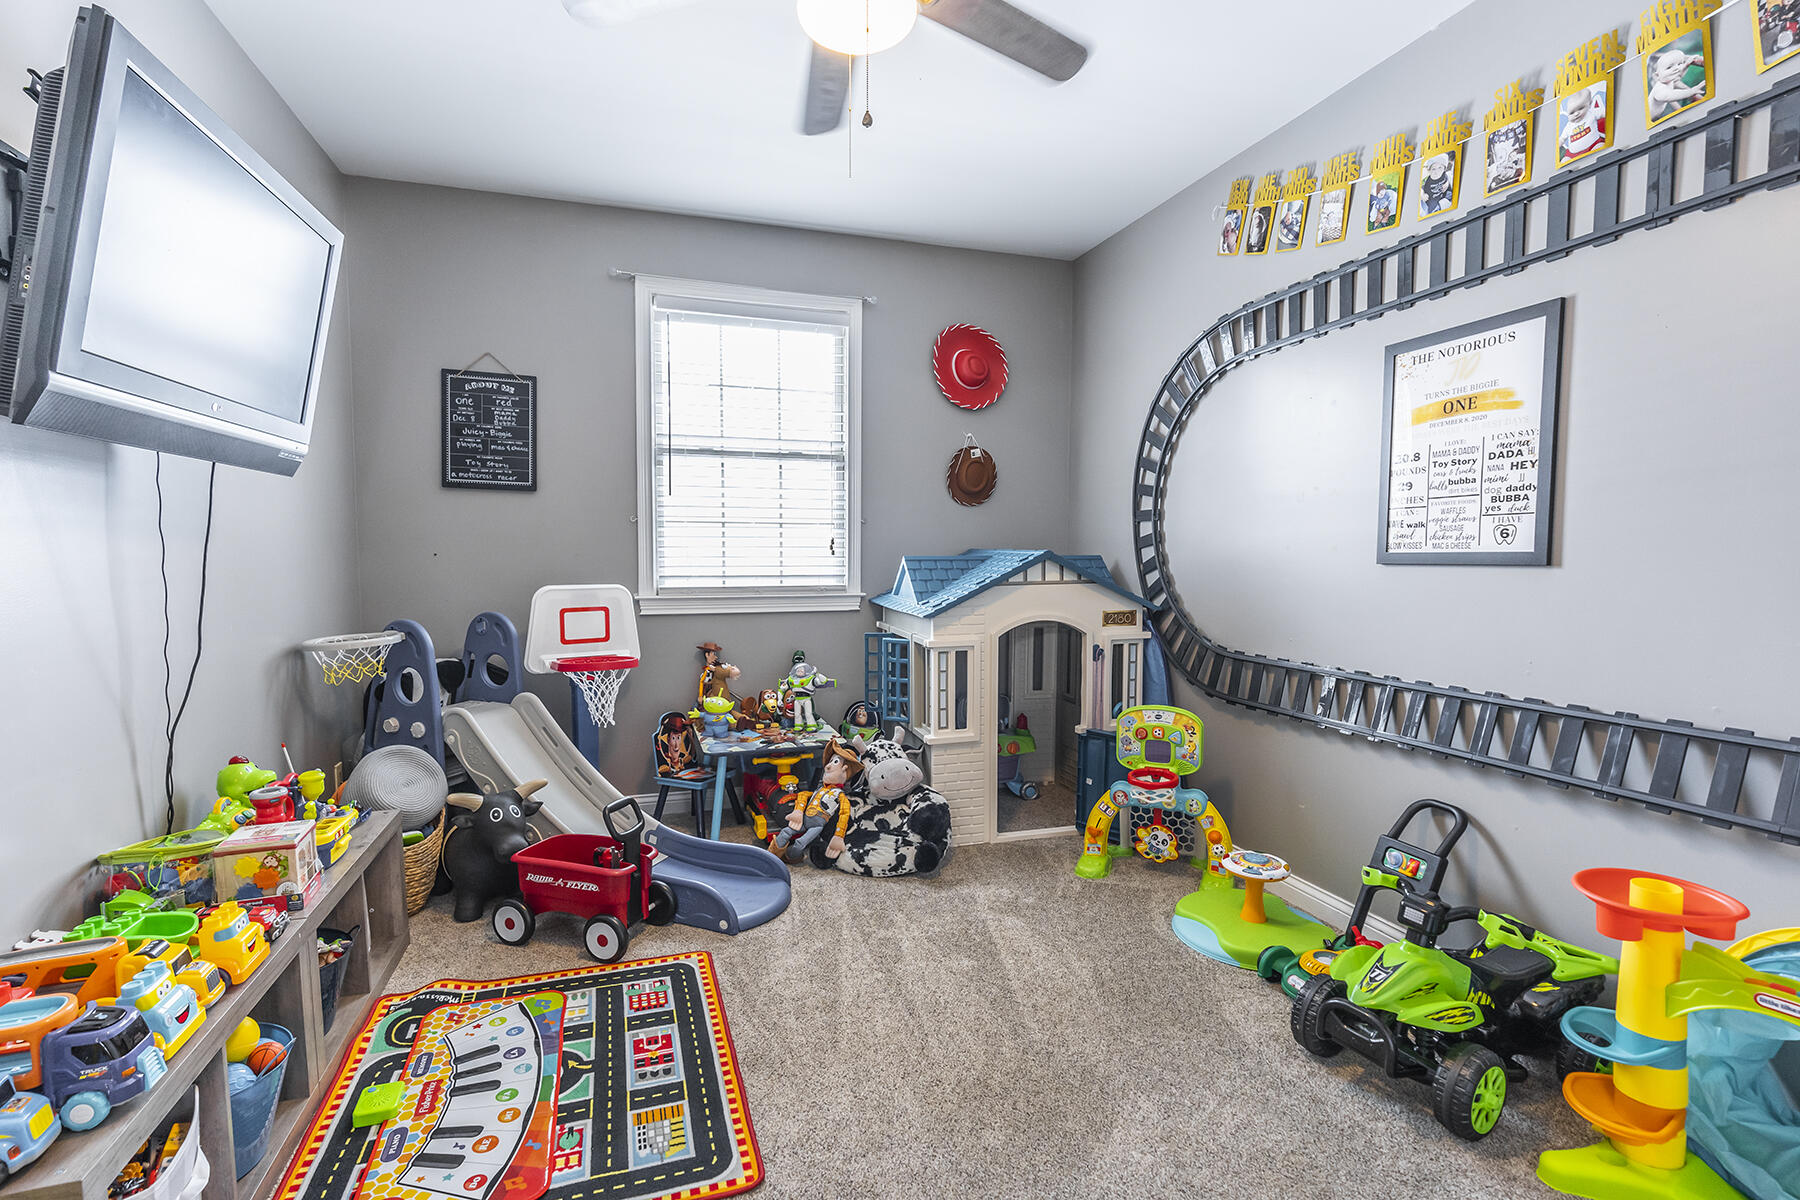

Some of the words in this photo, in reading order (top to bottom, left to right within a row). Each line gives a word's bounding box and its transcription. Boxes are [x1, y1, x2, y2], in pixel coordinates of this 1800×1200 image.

[1556, 28, 1618, 76] SEVEN
[1494, 78, 1521, 101] SIX
[1427, 110, 1456, 138] FIVE
[1374, 133, 1406, 155] FOUR
[1323, 152, 1356, 174] THREE
[1410, 352, 1435, 366] THE
[1438, 331, 1516, 359] NOTORIOUS
[464, 381, 500, 391] ABOUT
[1424, 389, 1450, 401] TURNS
[1452, 385, 1469, 396] THE
[1469, 379, 1500, 392] BIGGIE
[496, 399, 513, 407] red
[1443, 396, 1478, 415] ONE
[452, 414, 466, 422] Dec
[1429, 418, 1463, 429] DECEMBER
[1472, 414, 1488, 422] 2020
[1497, 432, 1516, 440] CAN
[456, 441, 483, 452] playing
[1496, 440, 1530, 449] mama
[1432, 449, 1451, 458] MAMA
[1458, 445, 1480, 456] DADDY
[1488, 449, 1524, 460] DADA
[465, 459, 481, 468] Toy
[1432, 460, 1449, 469] Toy
[1450, 458, 1478, 467] Story
[1487, 464, 1505, 472] NANA
[1510, 459, 1538, 471] HEY
[1448, 477, 1477, 486] bubba
[1484, 473, 1509, 484] mimi
[1484, 487, 1502, 495] dog
[1505, 483, 1537, 492] daddy
[1491, 494, 1530, 503] BUBBA
[1441, 507, 1467, 515] WAFFLES
[1485, 505, 1501, 514] yes
[1439, 524, 1465, 532] SAUSAGE
[1500, 528, 1510, 538] 6
[1429, 530, 1454, 541] chicken
[1402, 542, 1423, 550] KISSES
[1450, 542, 1472, 550] CHEESE
[526, 873, 555, 884] RADIO
[565, 880, 600, 892] FLYER
[80, 1065, 109, 1075] TRUCK
[388, 1134, 401, 1155] PIANO
[469, 1177, 481, 1189] DO
